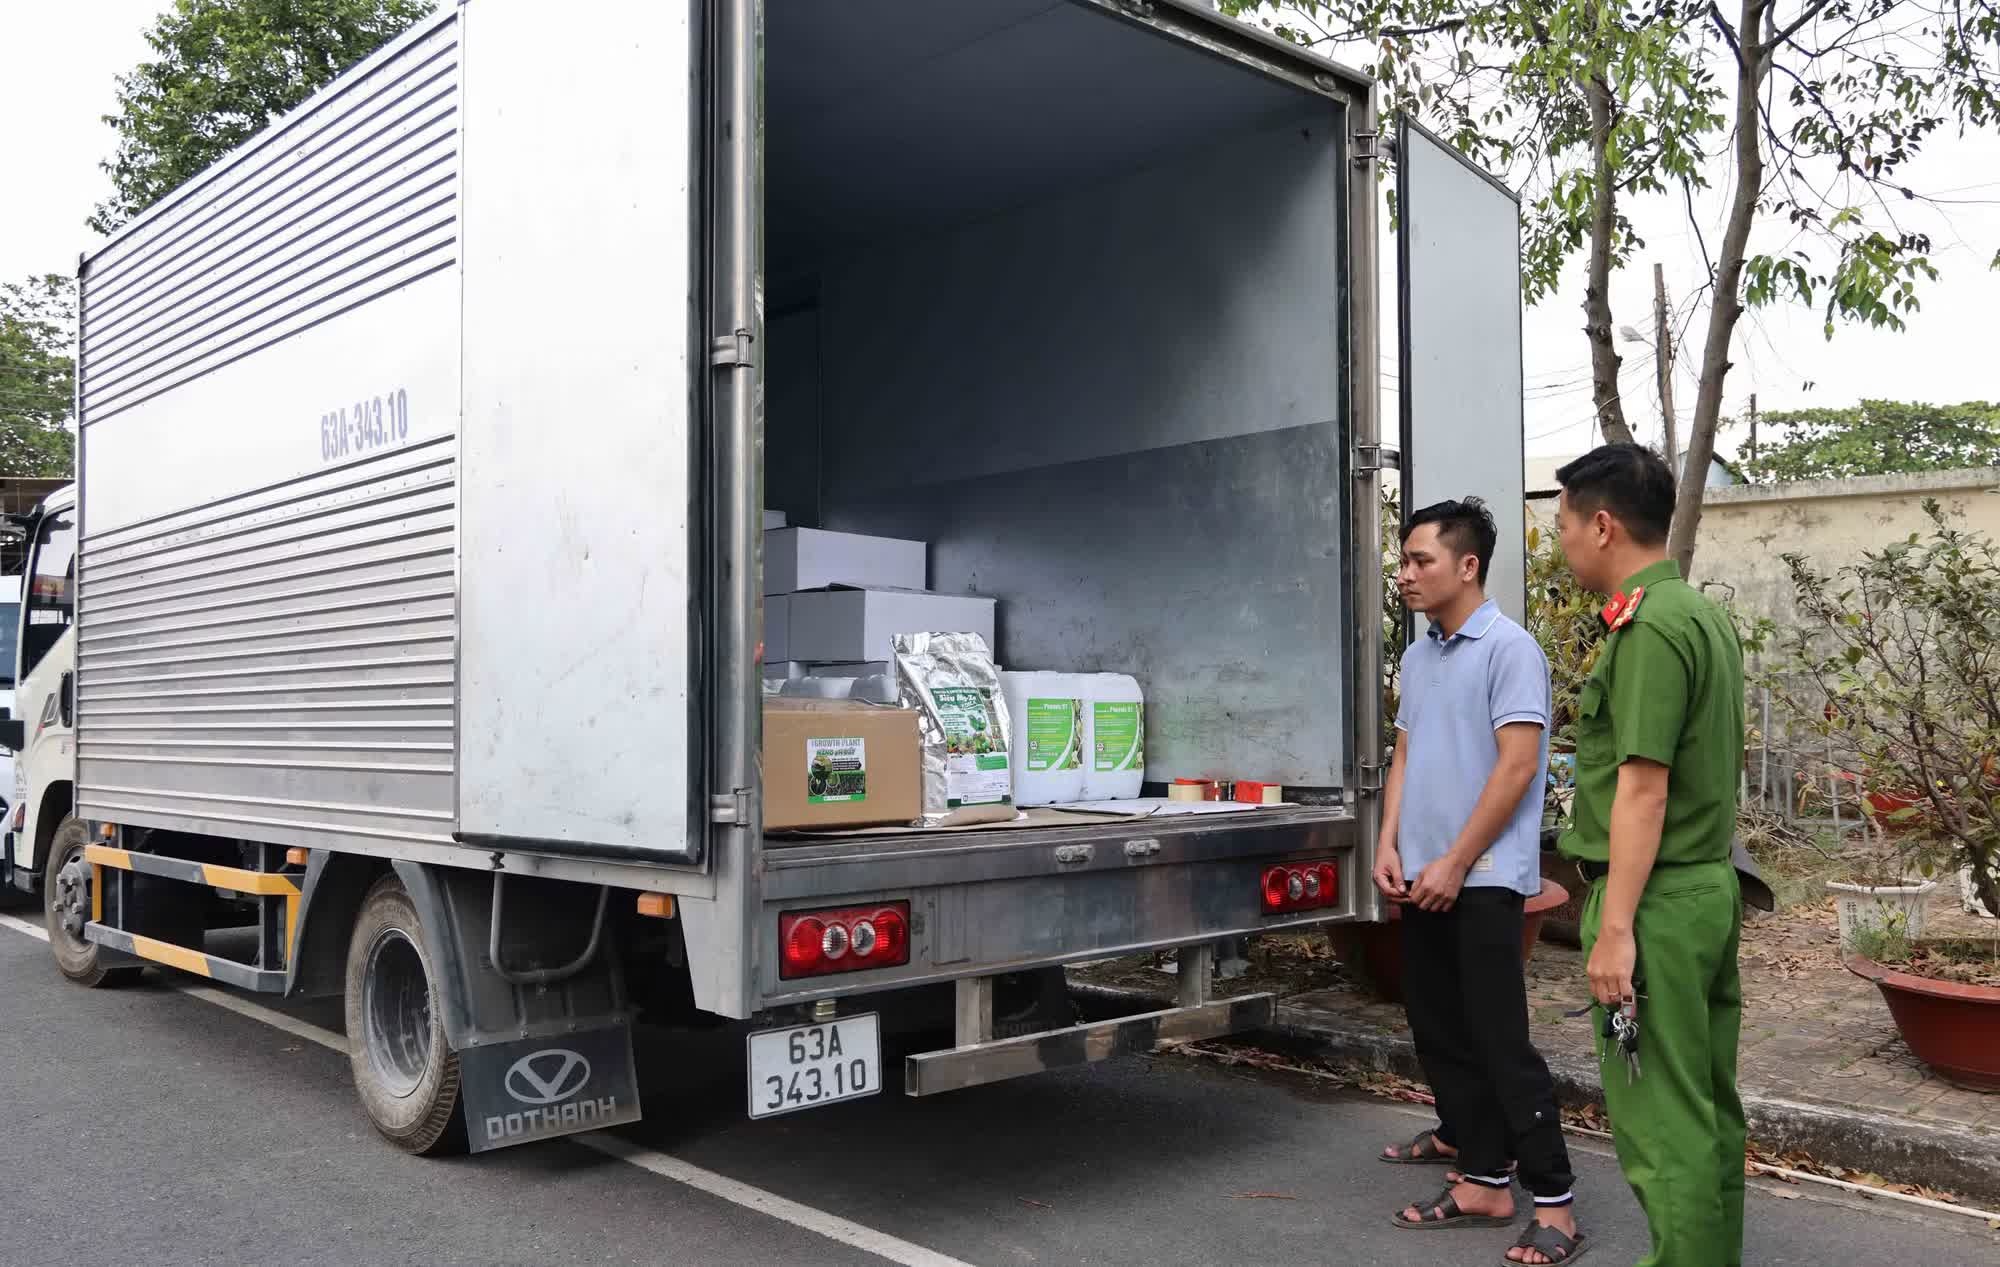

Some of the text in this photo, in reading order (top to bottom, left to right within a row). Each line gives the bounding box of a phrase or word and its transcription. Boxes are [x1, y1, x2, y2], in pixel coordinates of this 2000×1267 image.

[321, 387, 408, 462] 63A-343.10
[788, 1024, 843, 1065] 63A
[766, 1058, 866, 1109] 343.10
[486, 1095, 616, 1140] DOTHANH
